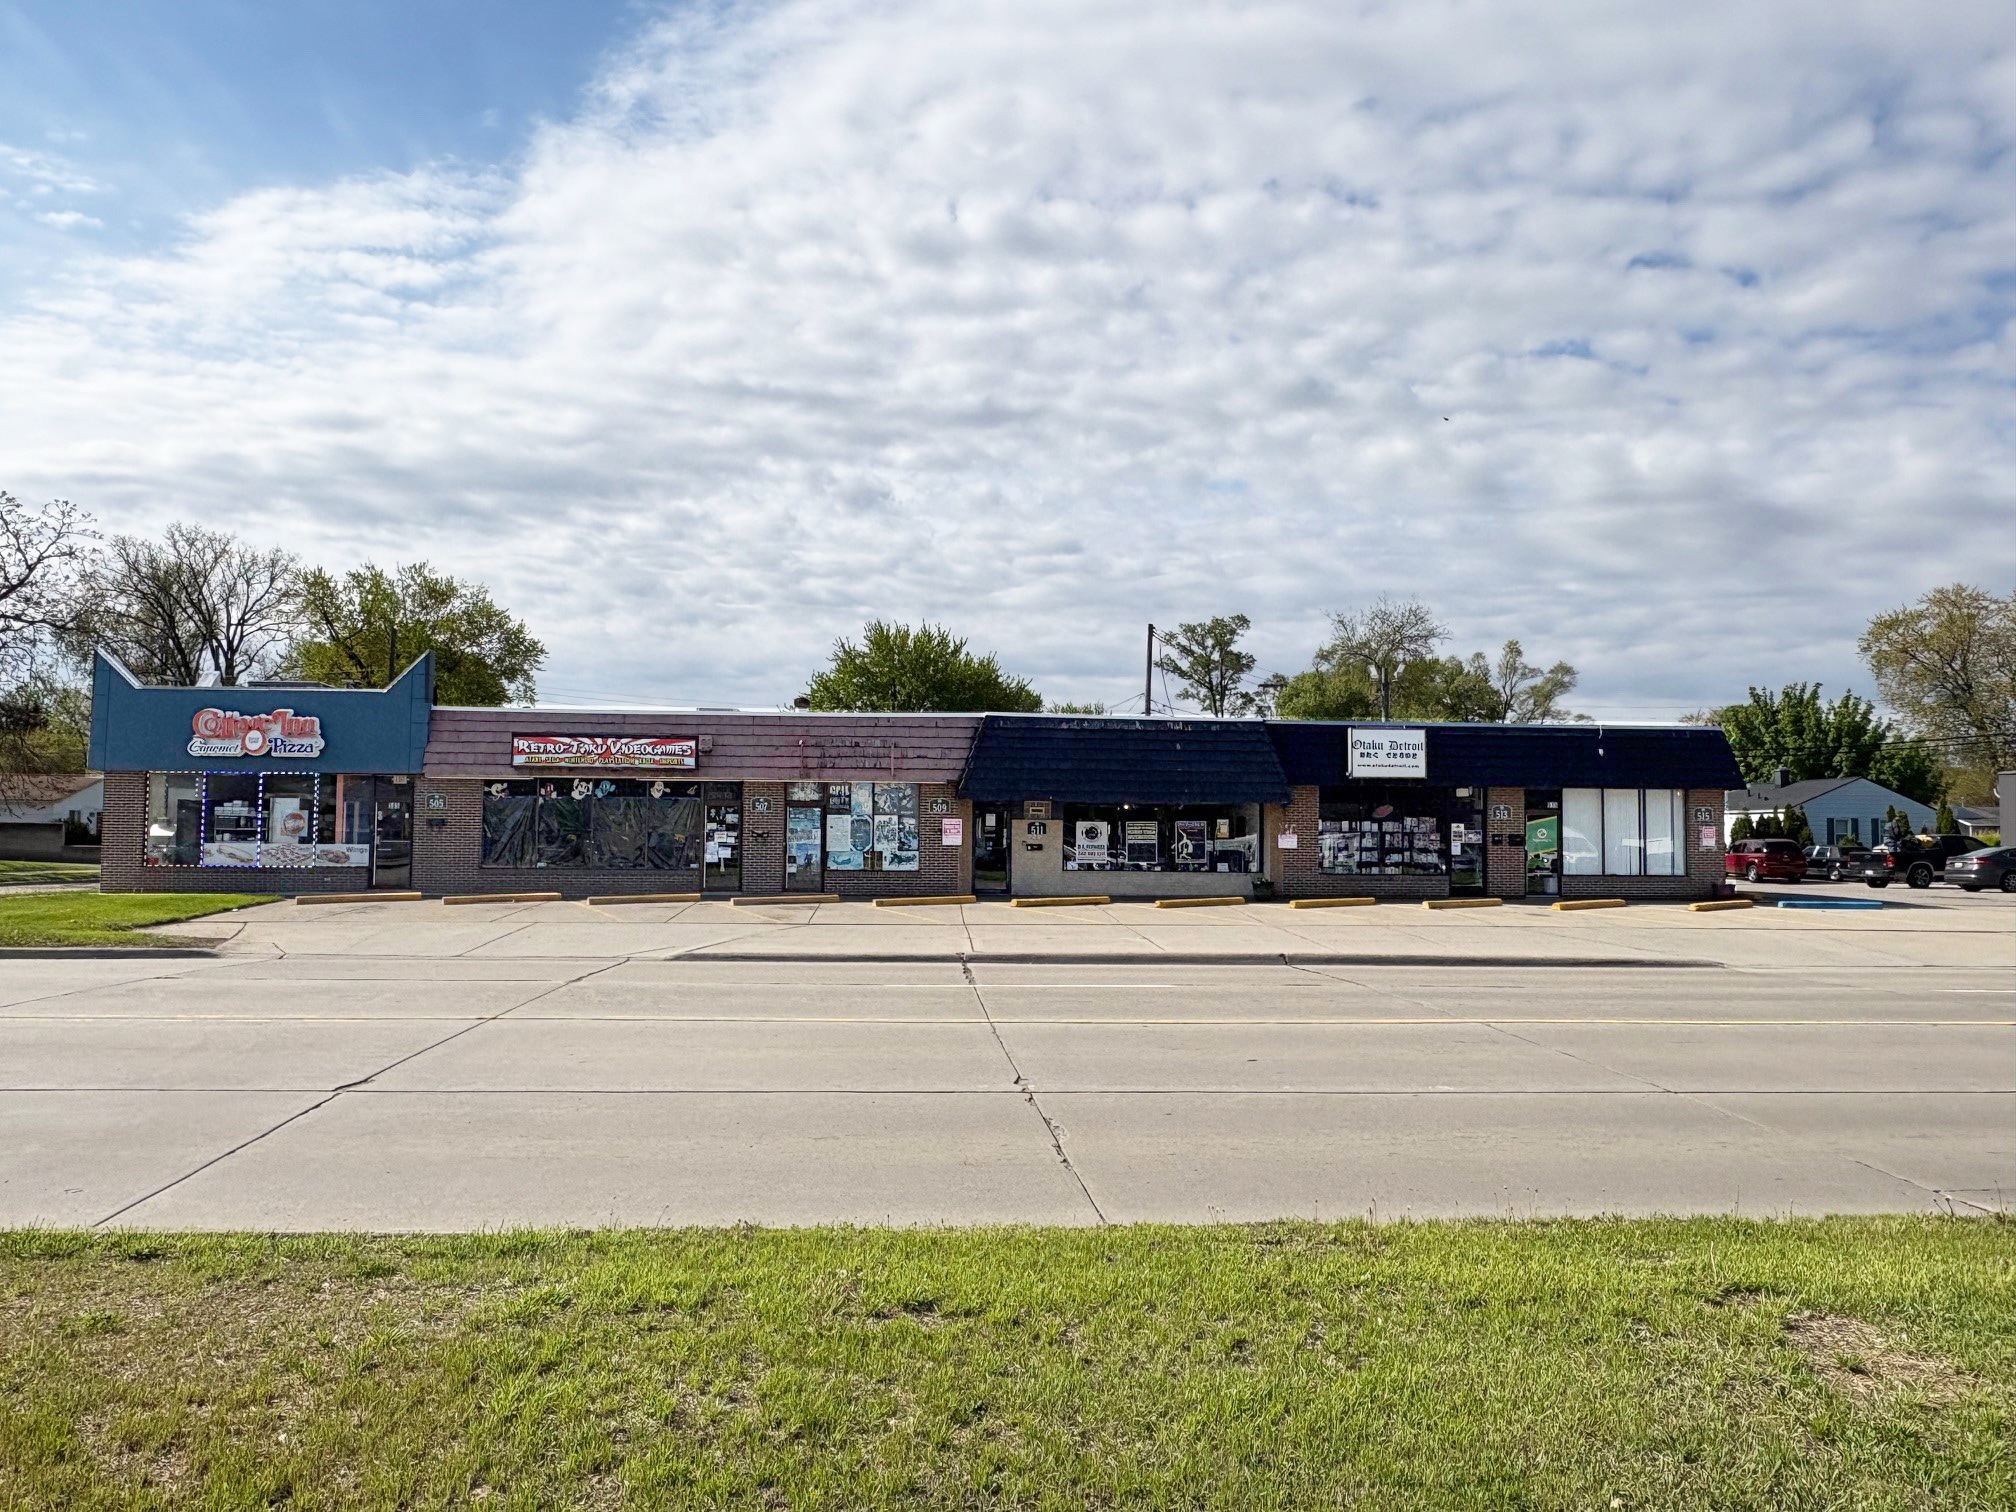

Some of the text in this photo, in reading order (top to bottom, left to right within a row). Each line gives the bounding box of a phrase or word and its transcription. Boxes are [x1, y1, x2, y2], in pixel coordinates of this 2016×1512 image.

[268, 737, 315, 754] Pizza
[609, 741, 692, 755] VIDEOGAMES
[1352, 739, 1424, 751] Otaku Detroit
[429, 799, 444, 808] 505
[755, 802, 768, 811] 507
[932, 803, 947, 812] 509
[1495, 810, 1508, 819] 513
[1697, 811, 1710, 820] 515
[1030, 825, 1043, 835] 511
